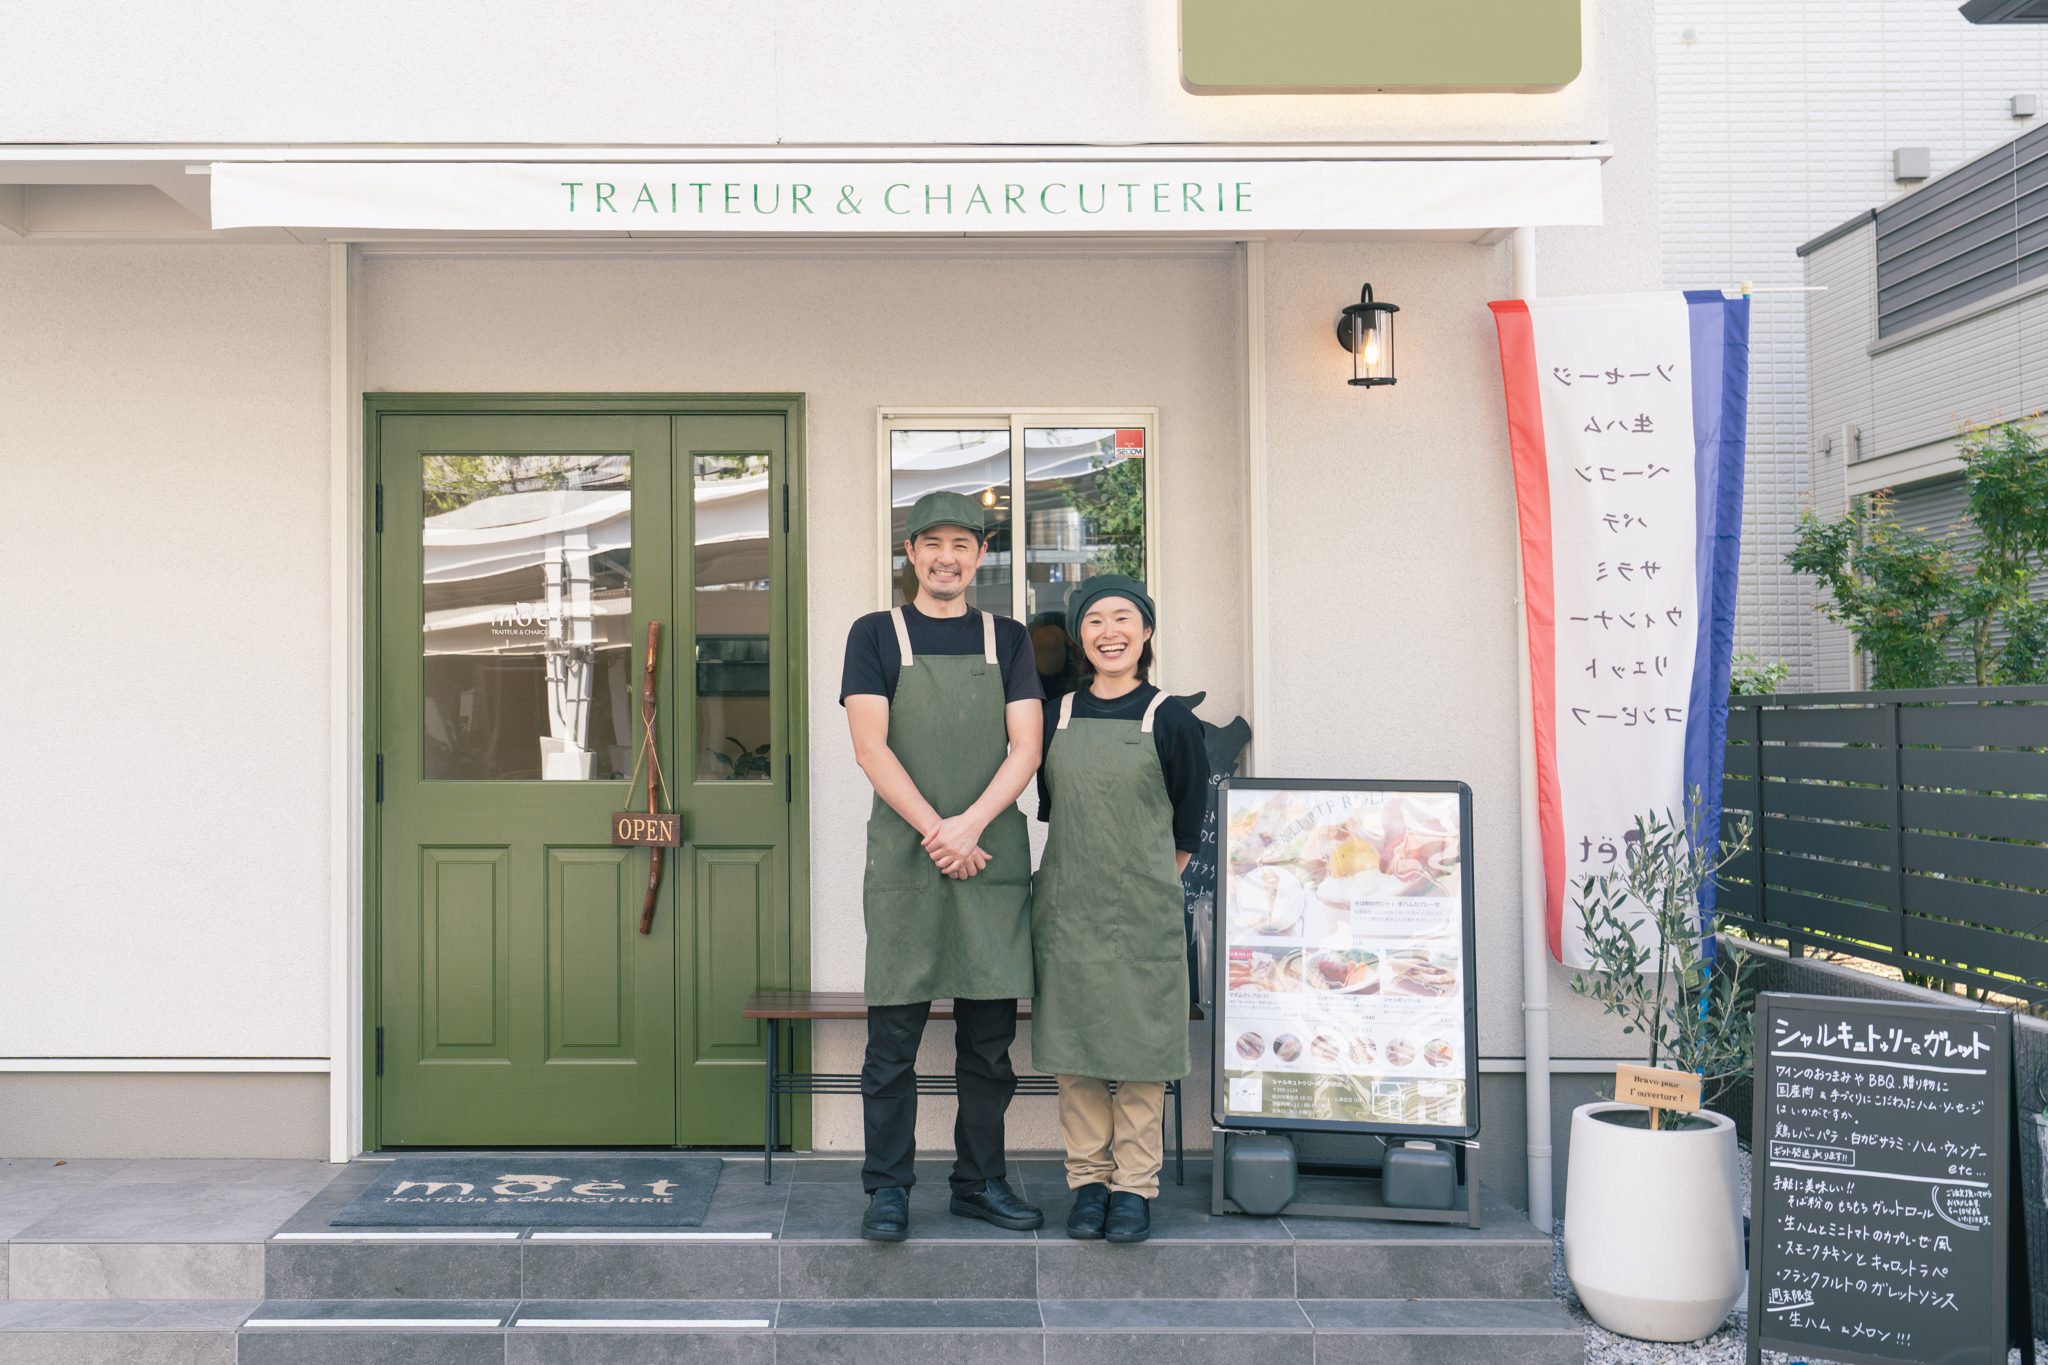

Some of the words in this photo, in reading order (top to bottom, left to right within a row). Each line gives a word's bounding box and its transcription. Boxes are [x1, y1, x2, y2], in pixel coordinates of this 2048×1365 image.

[561, 182, 816, 215] TRAITEUR
[836, 183, 863, 215] &
[884, 182, 1253, 215] CHARCUTERIE
[1116, 448, 1142, 456] SECOM
[1343, 792, 1390, 809] ROLL
[618, 818, 673, 842] OPEN
[1634, 1075, 1659, 1085] Bravo
[1661, 1080, 1681, 1089] pour
[517, 1196, 674, 1204] CHARCUTERIE
[1768, 1287, 1814, 1305] 週末限定
